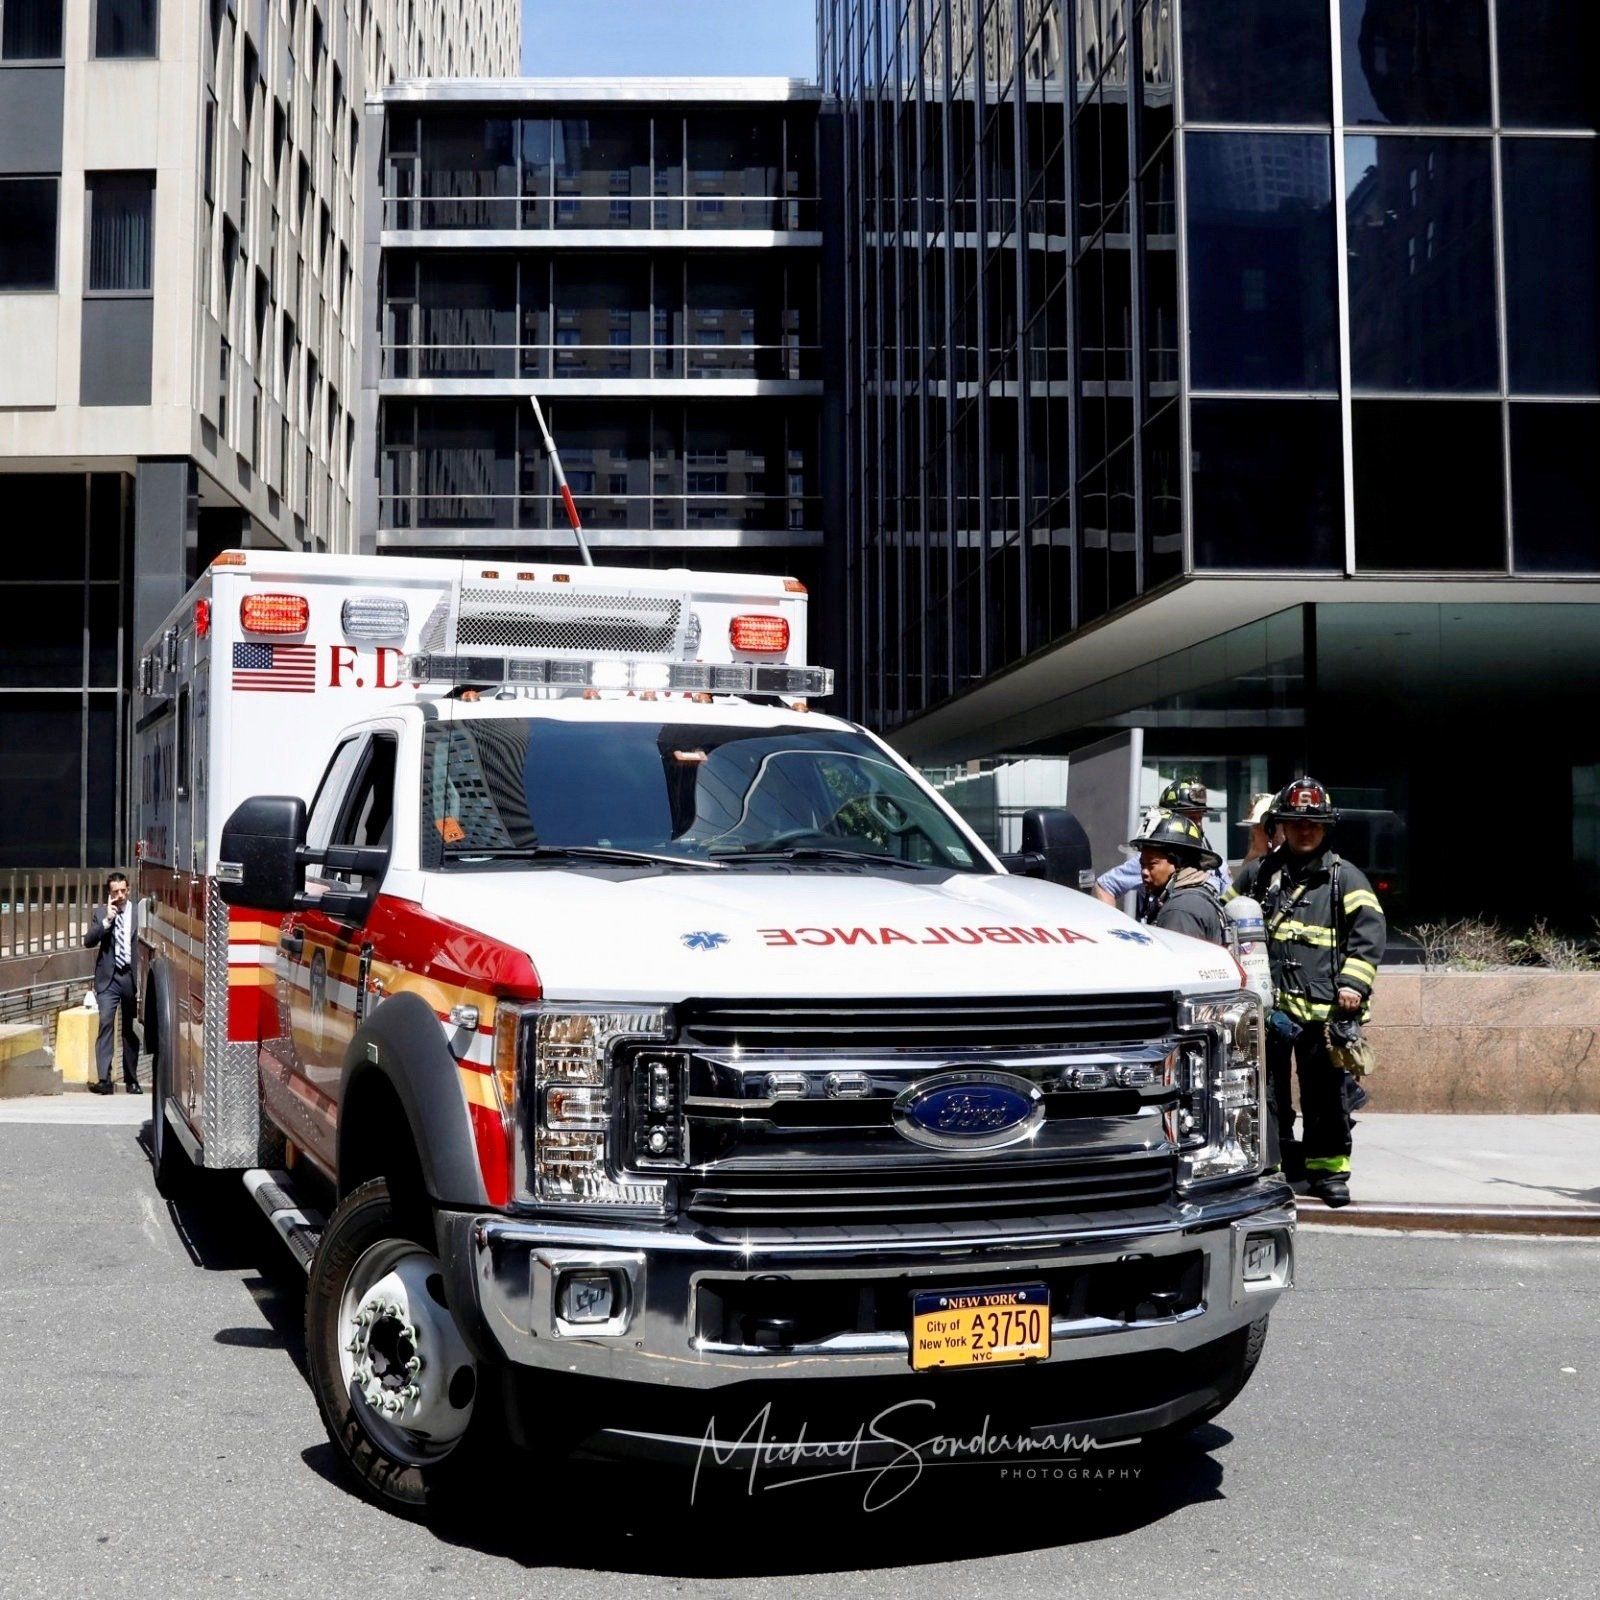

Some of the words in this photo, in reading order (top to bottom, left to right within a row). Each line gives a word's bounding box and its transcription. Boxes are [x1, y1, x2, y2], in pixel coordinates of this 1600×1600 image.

[1242, 959, 1265, 967] SCOTT
[937, 1093, 1008, 1127] Ford
[948, 1297, 980, 1309] NEW
[983, 1293, 1018, 1306] YORK
[926, 1321, 947, 1333] City
[950, 1319, 960, 1330] of
[987, 1309, 1040, 1348] 3750
[919, 1338, 942, 1350] New
[944, 1336, 967, 1348] York
[972, 1352, 993, 1361] NYC
